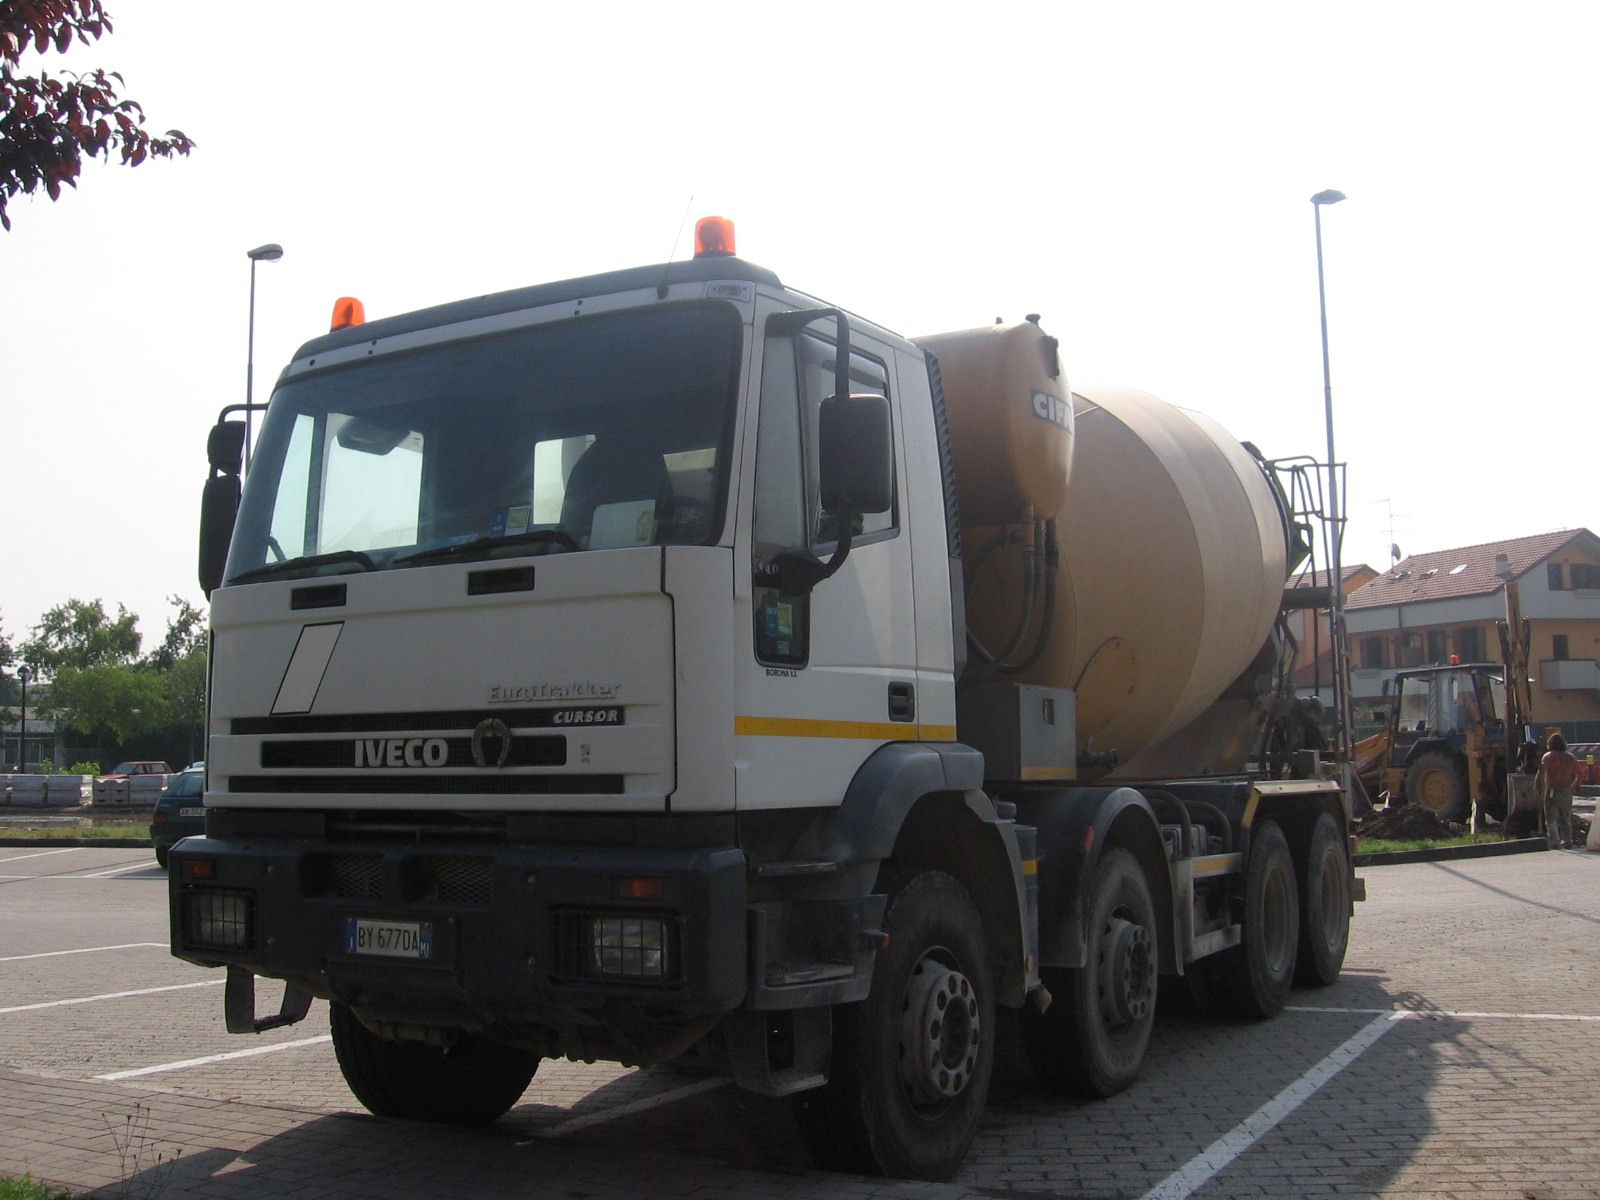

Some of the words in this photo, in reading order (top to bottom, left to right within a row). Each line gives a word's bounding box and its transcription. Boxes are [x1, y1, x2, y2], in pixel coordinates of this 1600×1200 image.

[552, 709, 619, 724] CURSOR
[354, 738, 449, 768] IVECO
[358, 926, 374, 948] BY
[377, 927, 419, 952] 677DA
